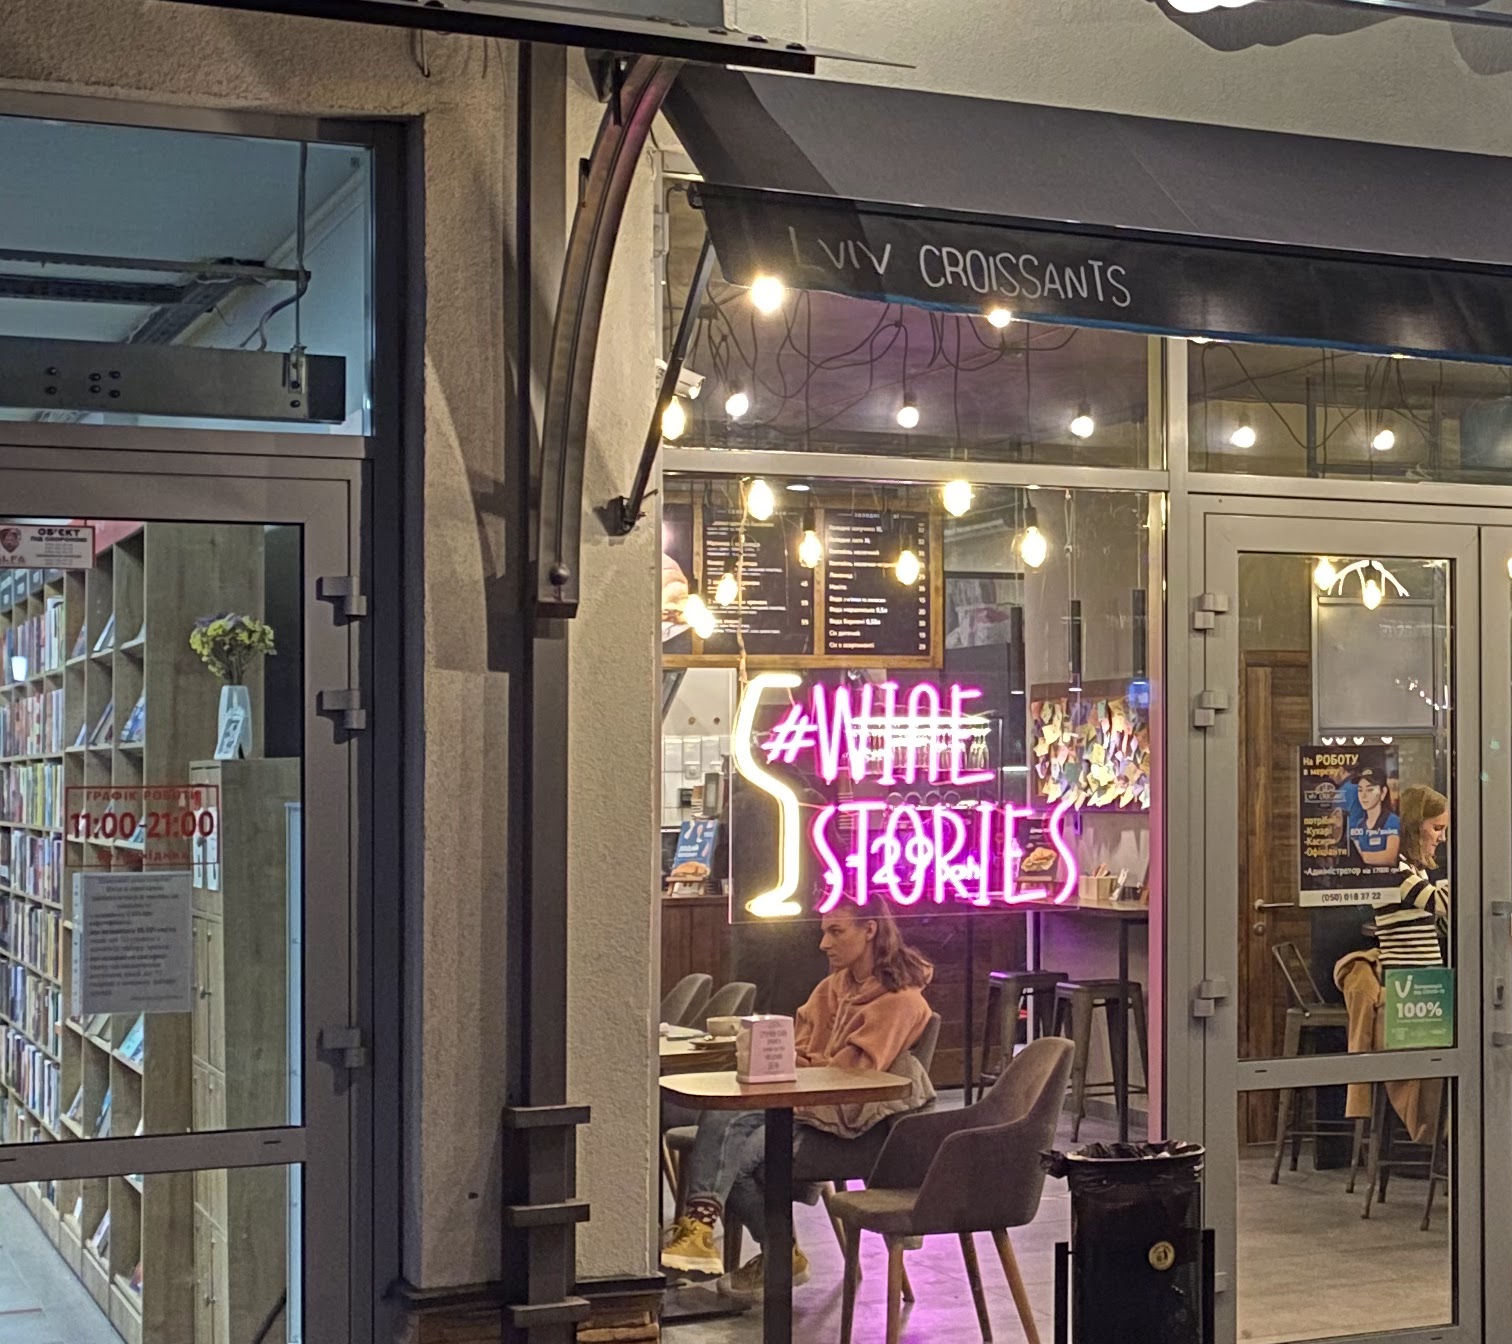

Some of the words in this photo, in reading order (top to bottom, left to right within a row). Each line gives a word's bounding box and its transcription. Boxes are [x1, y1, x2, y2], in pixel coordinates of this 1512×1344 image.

[919, 244, 1132, 307] CROISSANTS
[1316, 754, 1359, 766] РОБОТУ
[86, 790, 137, 801] ГРАФІК
[812, 799, 1079, 913] STORIES
[1321, 893, 1342, 902] (050)
[1372, 892, 1381, 900] 22
[1396, 1002, 1443, 1018] 100%
